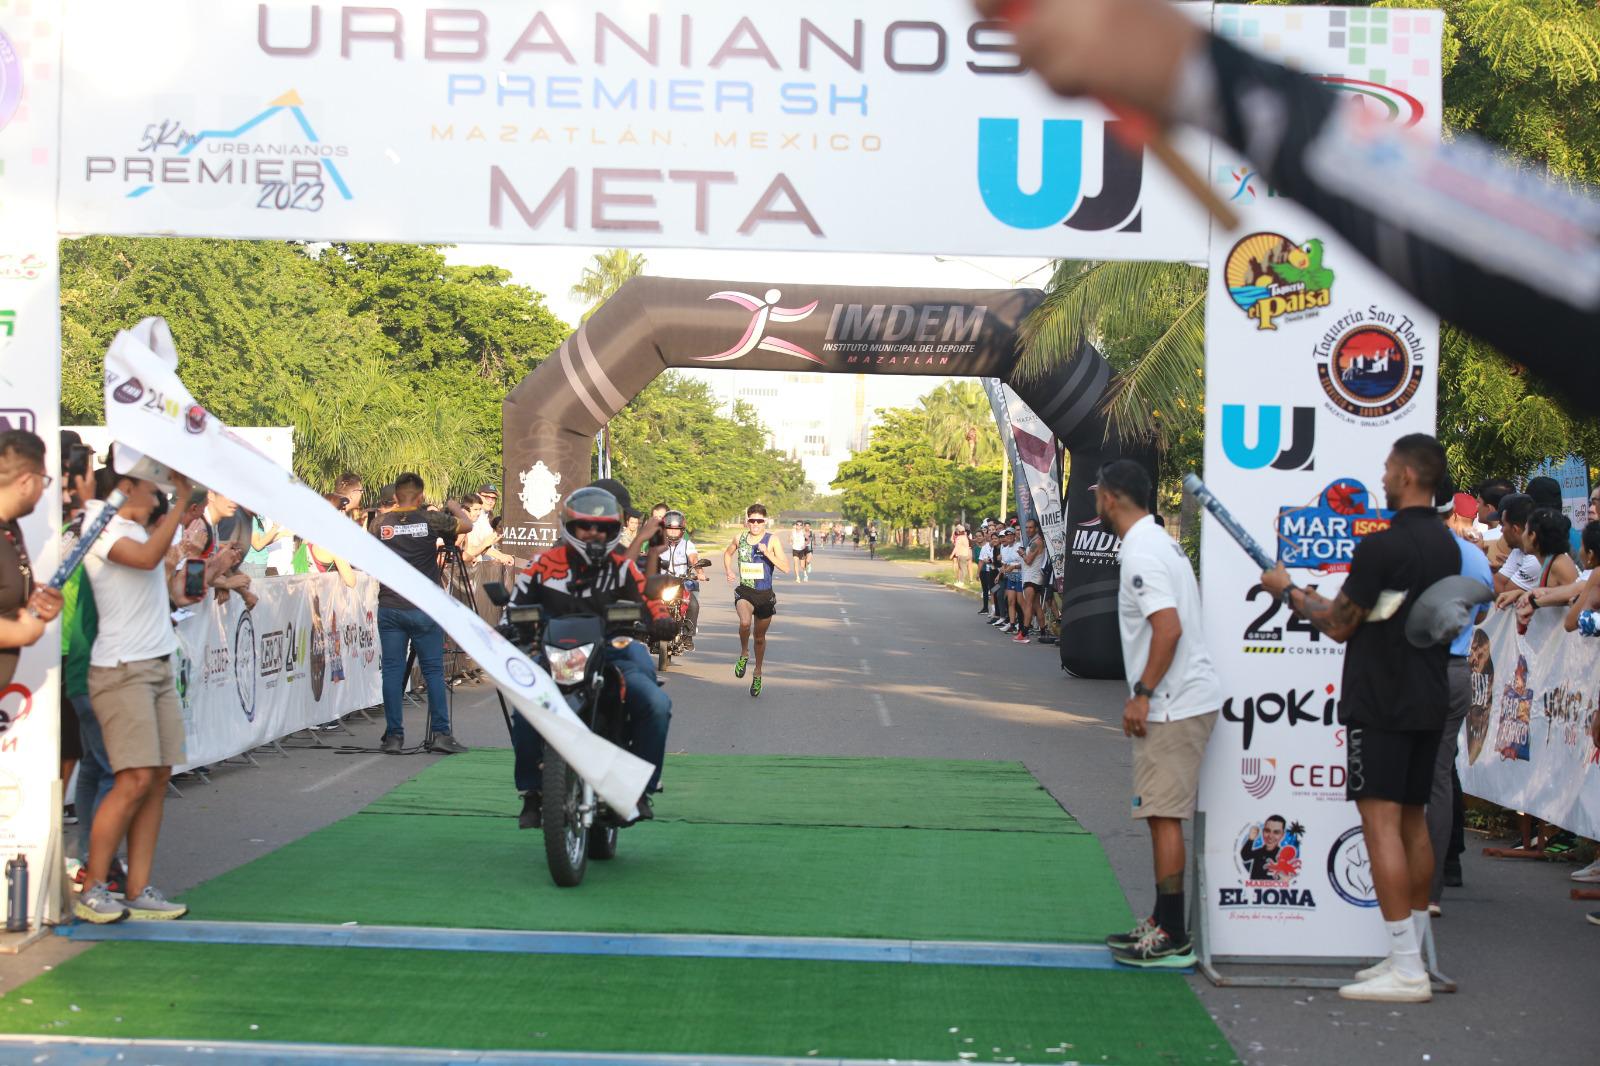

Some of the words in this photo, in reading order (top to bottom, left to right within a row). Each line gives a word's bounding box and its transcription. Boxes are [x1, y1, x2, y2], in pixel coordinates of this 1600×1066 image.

[258, 3, 1027, 75] URBANIANOS
[448, 73, 753, 113] PREMIER
[206, 142, 349, 158] URBANIANOS
[713, 131, 882, 152] MEXICO
[86, 156, 324, 184] PREMIER
[256, 180, 325, 212] 2023
[489, 165, 826, 238] META
[823, 303, 988, 342] IMDEM
[1369, 304, 1395, 325] San
[1392, 315, 1424, 361] Pablo
[822, 343, 868, 352] INSTITUTO
[869, 344, 917, 353] MUNICIPAL
[918, 345, 934, 353] DEL
[935, 345, 976, 353] DEPORTE
[502, 526, 559, 541] MAZATL
[1283, 517, 1347, 537] MAR
[1353, 520, 1391, 535] ISCO
[1072, 529, 1122, 552] IMDE
[1297, 538, 1356, 559] TOR
[1079, 557, 1121, 565] MAZATL
[1247, 632, 1279, 640] GRUPO
[1289, 646, 1345, 655] CONSTRU
[1289, 764, 1346, 788] CED
[1245, 879, 1290, 888] MARISCOS
[1219, 888, 1248, 906] EL
[1251, 888, 1316, 907] JONA
